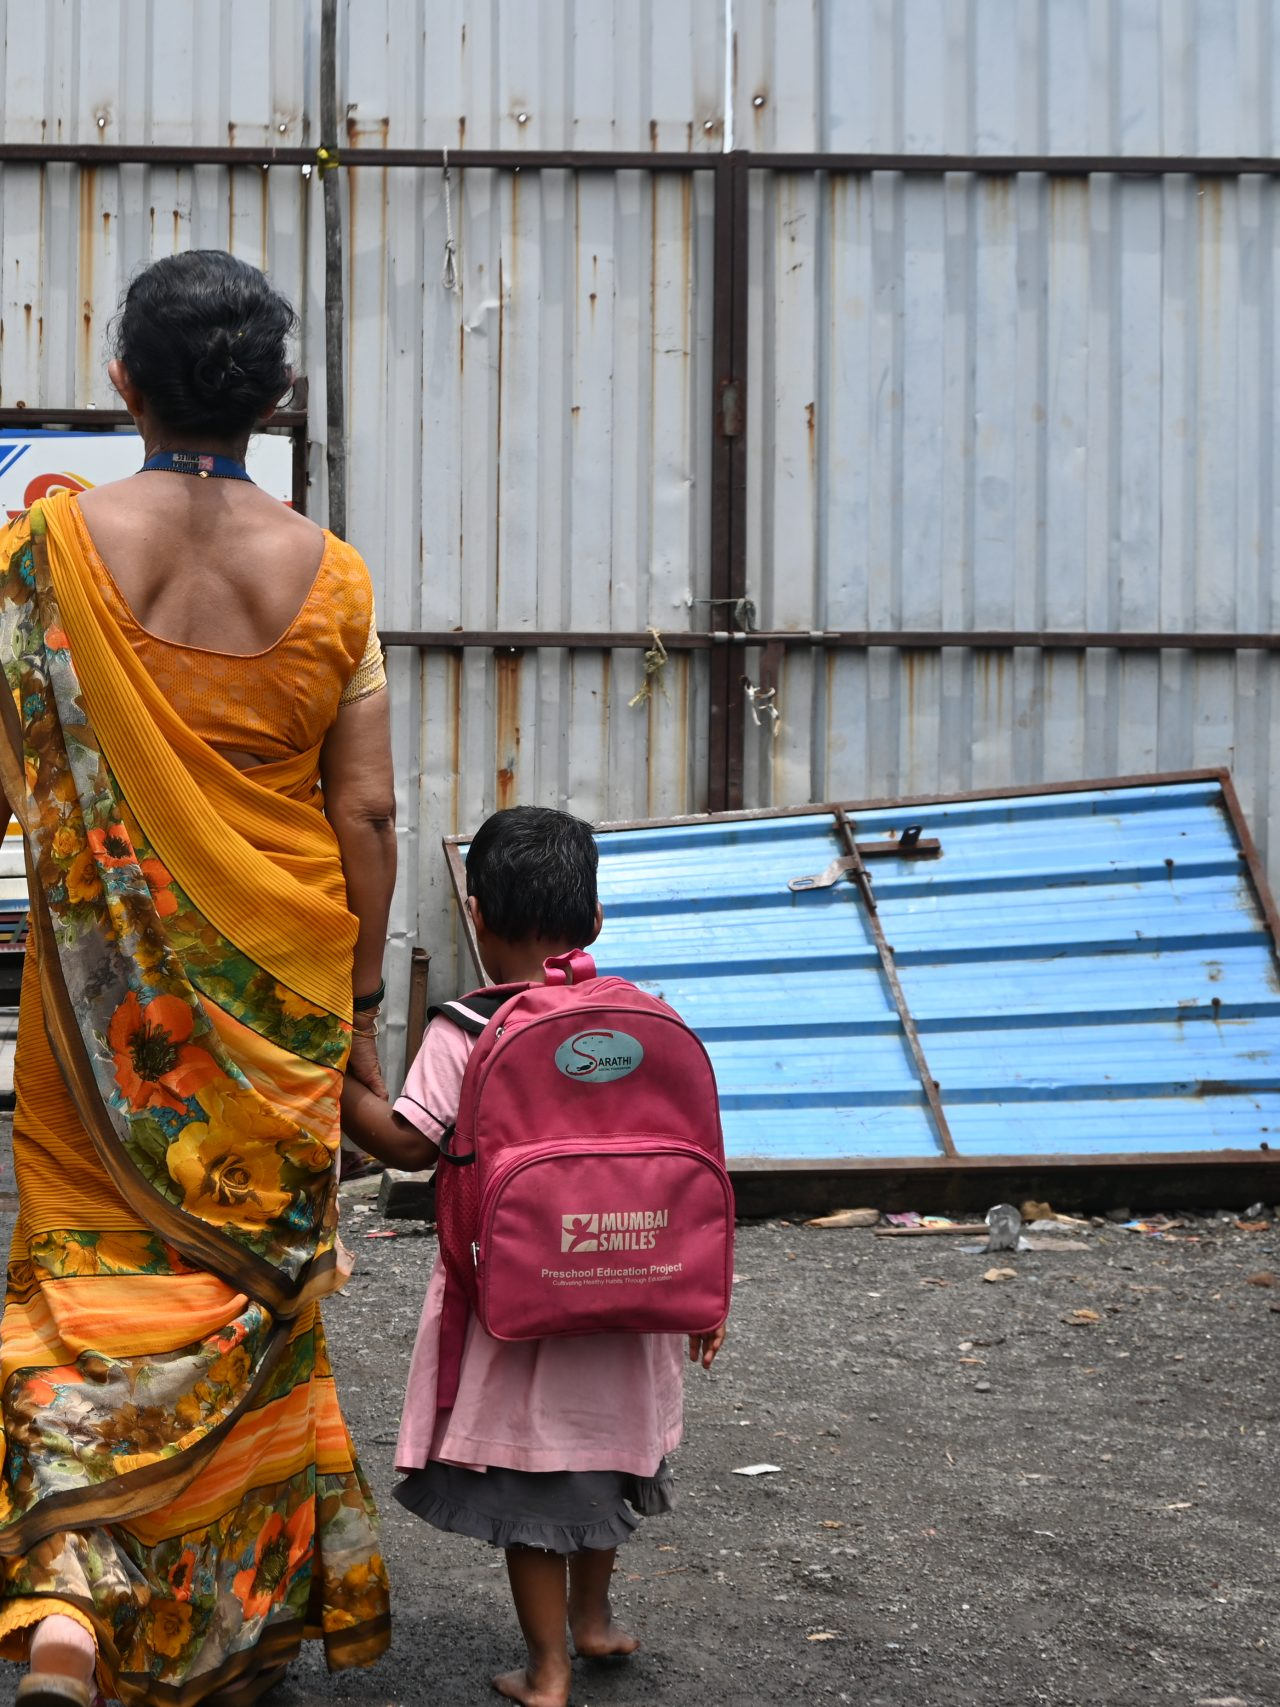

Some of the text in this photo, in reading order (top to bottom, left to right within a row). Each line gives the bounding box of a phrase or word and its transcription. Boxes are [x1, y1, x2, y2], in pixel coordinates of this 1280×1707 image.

[601, 1209, 668, 1232] MUMBAI
[600, 1230, 657, 1251] SMILES
[541, 1263, 682, 1278] Preschool Education Project
[647, 1275, 673, 1283] Education
